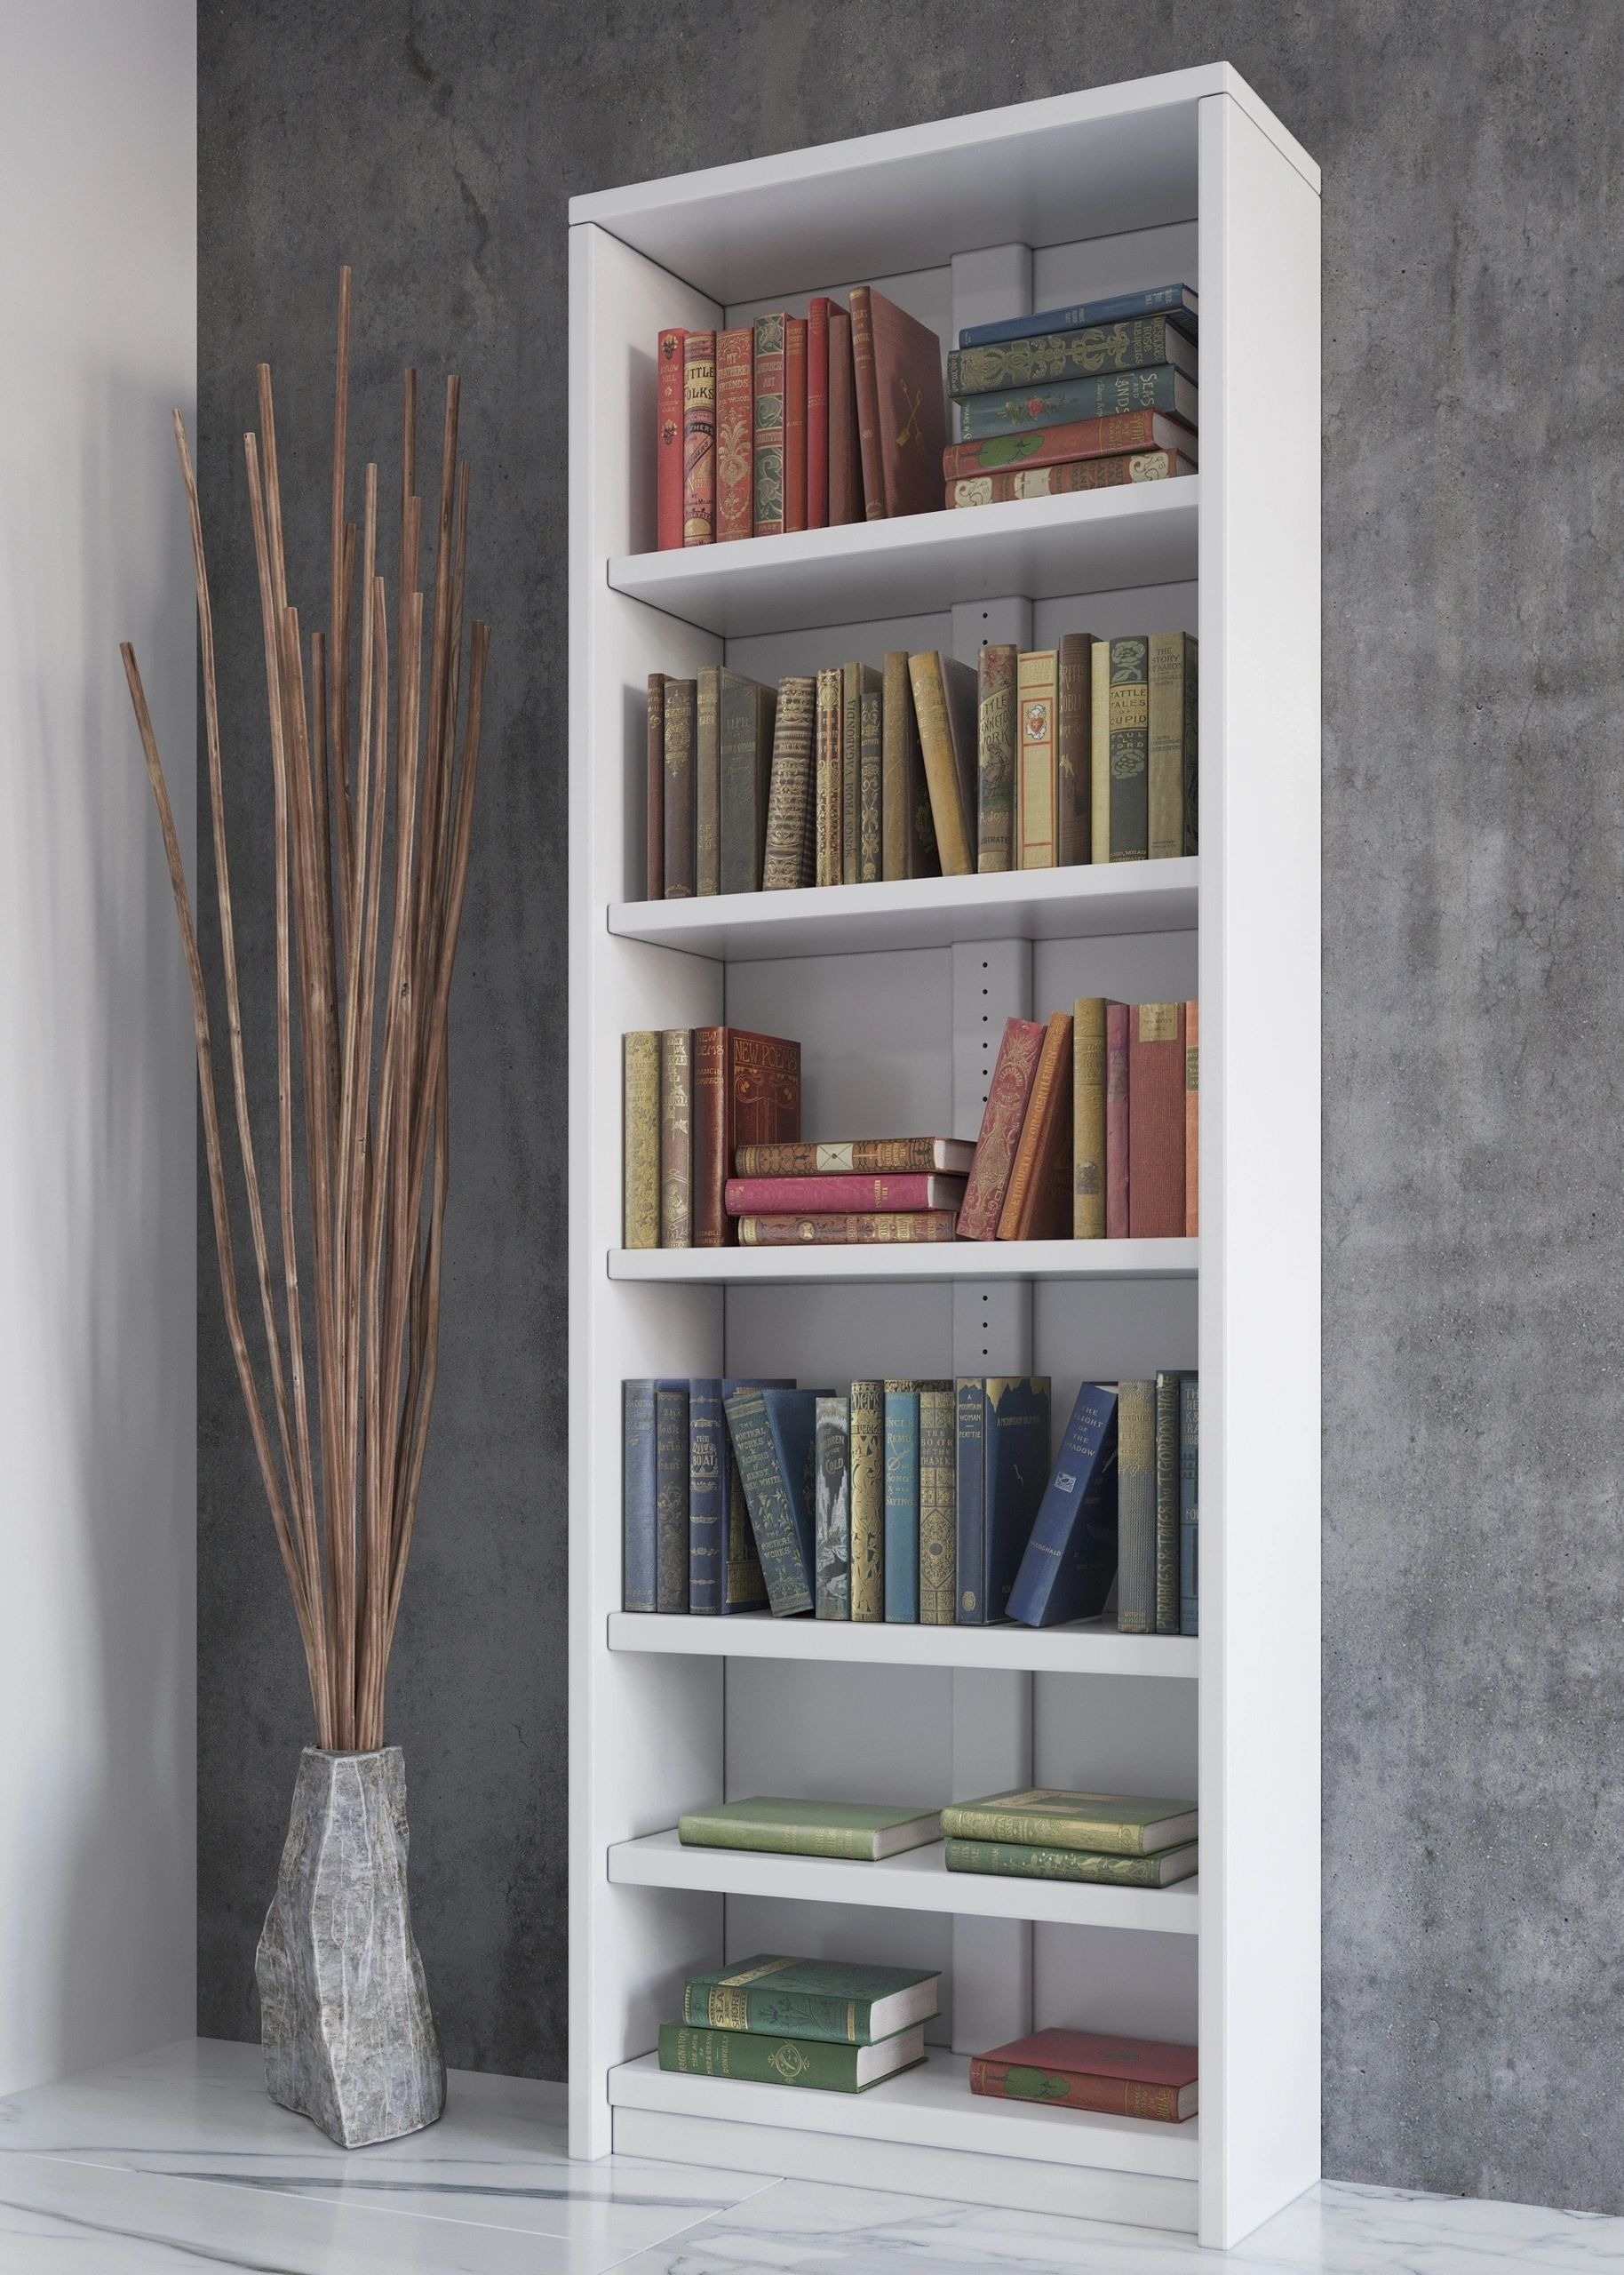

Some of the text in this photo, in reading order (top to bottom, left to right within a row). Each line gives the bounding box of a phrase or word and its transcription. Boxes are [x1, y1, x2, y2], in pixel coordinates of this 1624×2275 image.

[1143, 325, 1153, 352] ROSE
[718, 379, 749, 392] FRIENDS
[1114, 372, 1134, 413] LANDS
[1140, 372, 1158, 407] SEAS
[1157, 647, 1172, 656] THE
[1150, 654, 1180, 665] STORY
[1110, 688, 1146, 699] TATTLE
[1110, 699, 1146, 709] TALES
[1110, 714, 1147, 726] CUPID
[846, 699, 856, 780] VAGABONDIA
[981, 835, 1010, 845] STRATE
[697, 1031, 719, 1042] NEW
[735, 1040, 798, 1071] NEW POEMS
[1011, 1050, 1057, 1206] ETIQUETTE FOR GENTLEMEN
[896, 1215, 911, 1241] NATURA
[1157, 1375, 1174, 1411] HAKE
[1081, 1405, 1099, 1417] THE
[735, 1428, 766, 1441] POETICAL
[1073, 1433, 1089, 1444] THE
[737, 1438, 765, 1450] WORKS
[1157, 1415, 1174, 1471] GORDON
[692, 1455, 715, 1466] BOAT
[825, 1457, 844, 1475] COLD
[746, 1468, 769, 1481] HENRY
[1158, 1472, 1174, 1486] T.
[1158, 1506, 1174, 1546] TALES
[760, 1537, 792, 1551] POETICAL
[763, 1546, 791, 1560] WORKS
[1158, 1550, 1174, 1561] &
[1158, 1563, 1174, 1628] PARABLES
[716, 1992, 725, 2024] SEA
[730, 1988, 741, 2028] SHORE
